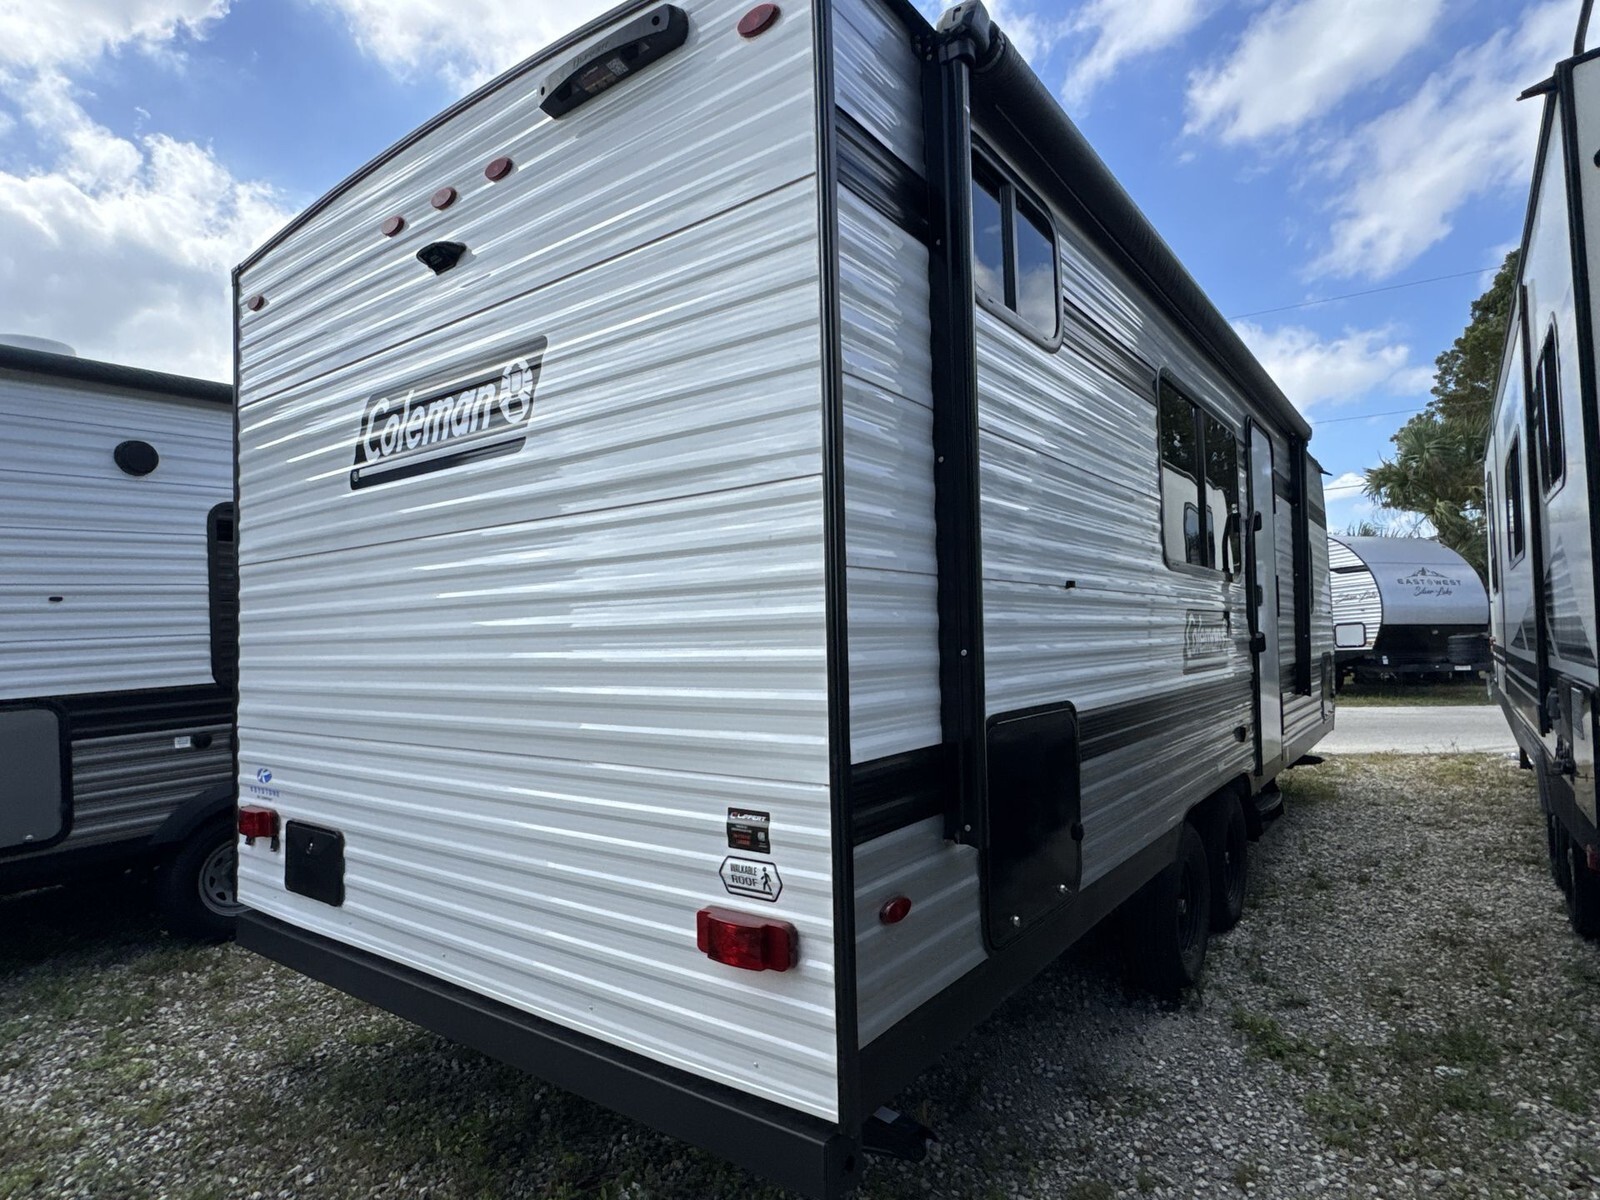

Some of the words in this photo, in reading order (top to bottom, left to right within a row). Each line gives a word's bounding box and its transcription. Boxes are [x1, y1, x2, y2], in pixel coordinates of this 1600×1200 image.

[363, 383, 496, 463] Coleman
[730, 863, 758, 876] WALKABLE
[731, 875, 759, 887] ROOF
